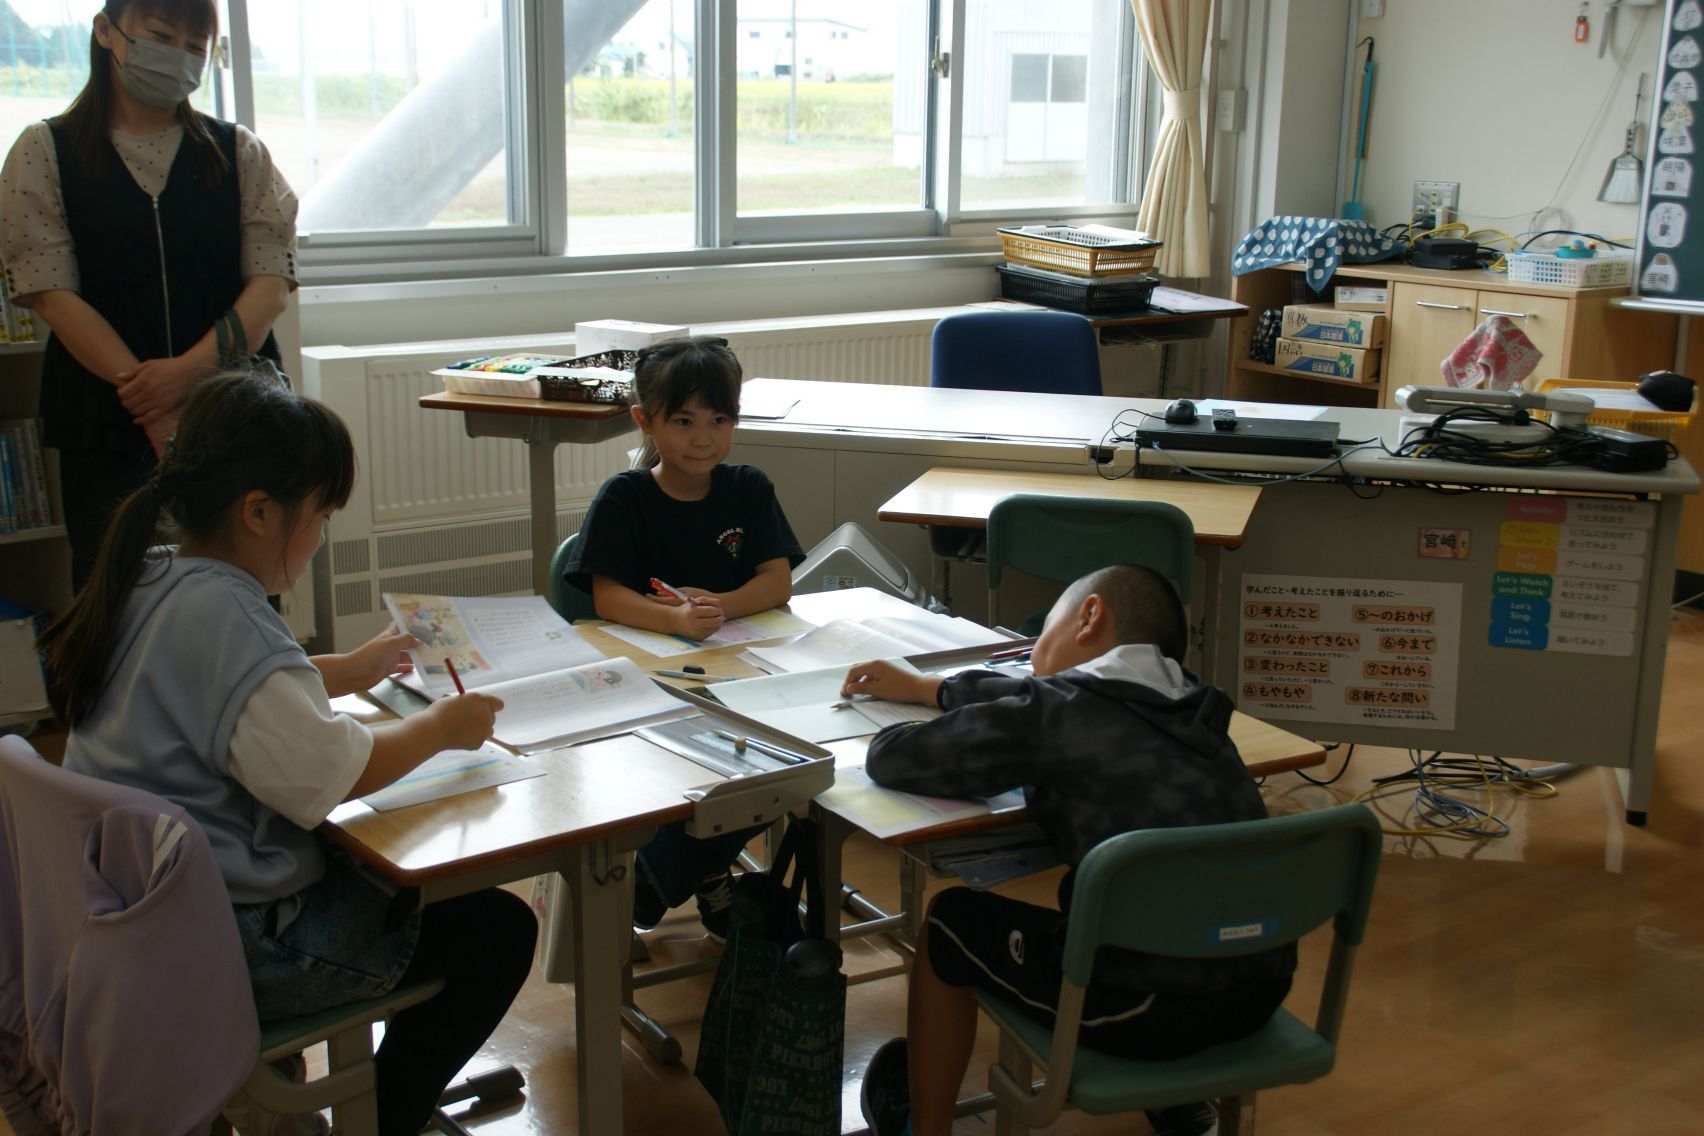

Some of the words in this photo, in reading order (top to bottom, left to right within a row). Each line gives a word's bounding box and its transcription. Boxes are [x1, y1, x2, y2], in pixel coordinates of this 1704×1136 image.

[1496, 575, 1517, 583] Let's
[1520, 577, 1549, 587] Watch
[1498, 585, 1517, 594] and
[1519, 586, 1545, 596] Think
[1510, 602, 1531, 611] Let's
[1509, 611, 1530, 622] Sing
[1508, 626, 1529, 636] Let's
[1504, 636, 1531, 645] Listen
